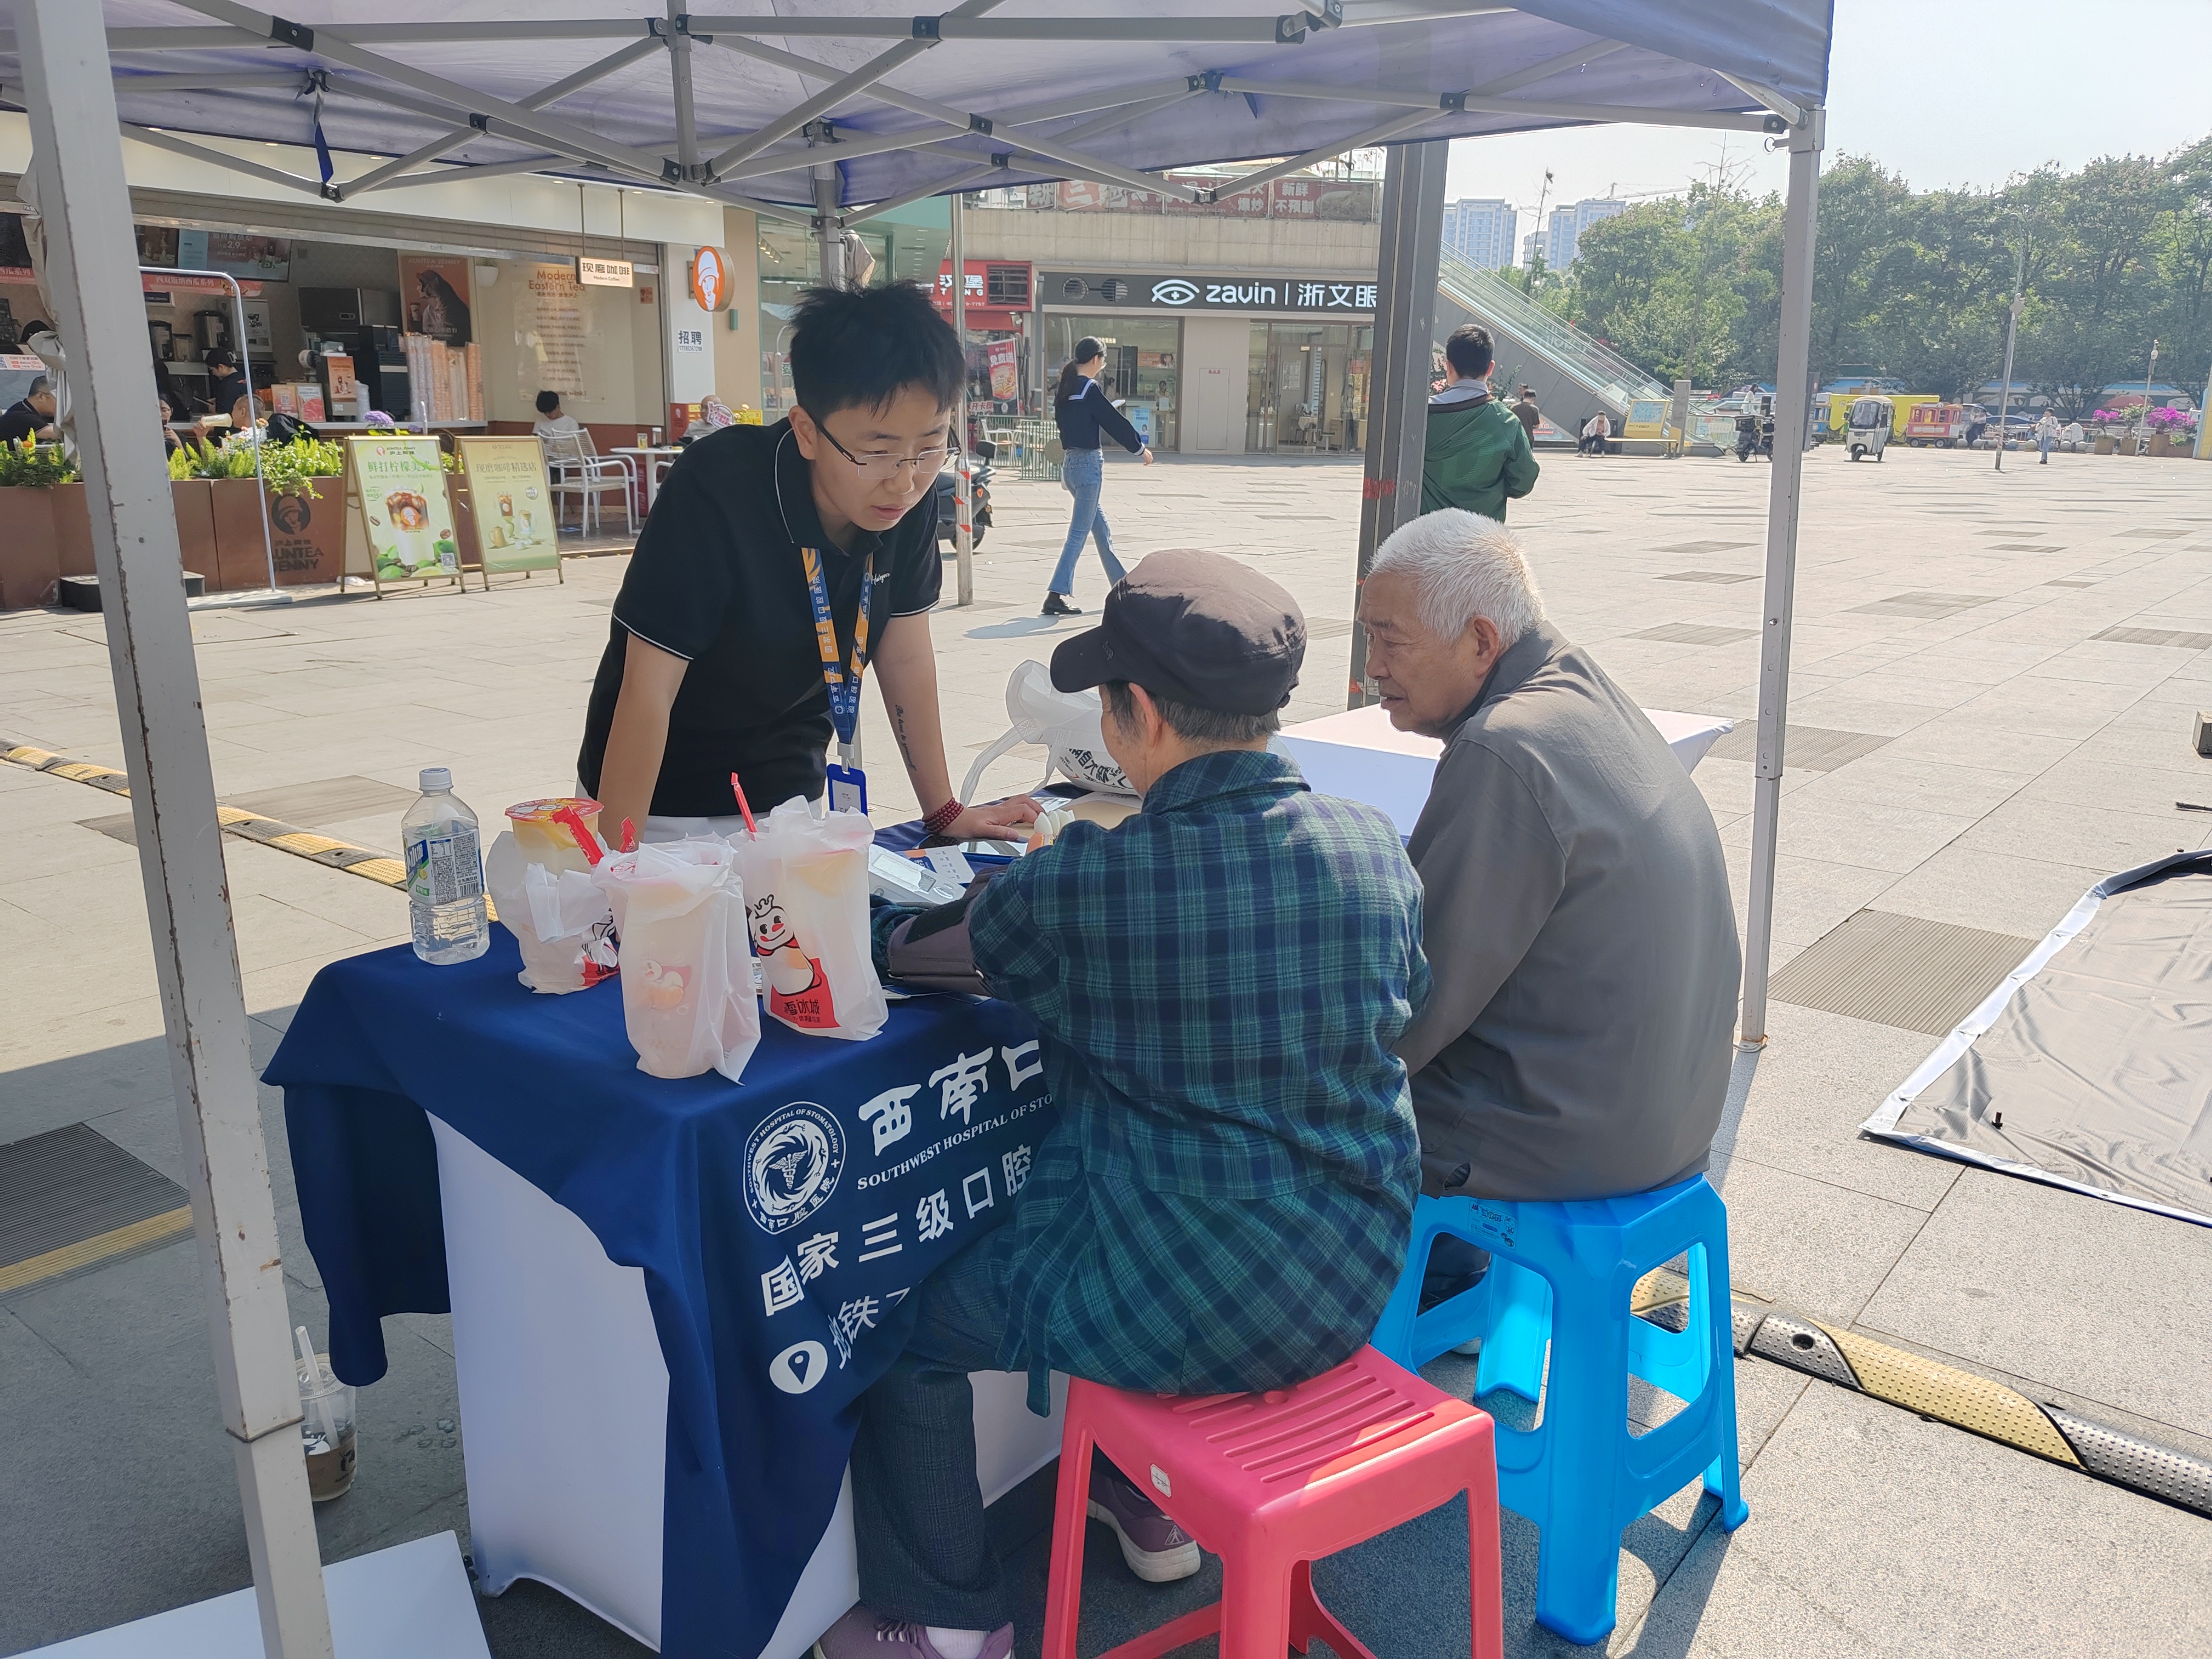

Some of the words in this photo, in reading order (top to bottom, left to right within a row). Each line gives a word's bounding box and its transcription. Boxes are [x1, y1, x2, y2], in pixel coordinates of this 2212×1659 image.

[1281, 182, 1309, 196] 新鲜
[1275, 199, 1315, 213] 不预制
[537, 269, 576, 280] Modern
[582, 262, 630, 275] 现磨咖啡
[529, 280, 565, 290] Eastern
[568, 281, 586, 291] Tea
[1206, 282, 1276, 304] zavin
[1297, 283, 1378, 308] 浙文眼
[679, 330, 702, 345] 招聘
[367, 460, 431, 472] 鲜打柠檬美式
[476, 461, 537, 474] 现磨咖啡精选店
[812, 575, 833, 654] 国家三级口腔医院
[846, 635, 864, 714] 国家三级口腔医院
[858, 1039, 1044, 1156] 西南口
[746, 1136, 760, 1195] SOUTHWEST
[759, 1110, 795, 1138] HOSPITAL
[805, 1108, 839, 1154] STOMATOLOGY
[857, 1142, 941, 1190] SOUTHWEST
[943, 1114, 1008, 1150] HOSPITAL
[1010, 1104, 1027, 1121] OF
[759, 1176, 836, 1232] 西南口腔医院
[760, 1144, 1032, 1317] 国家三级口腔
